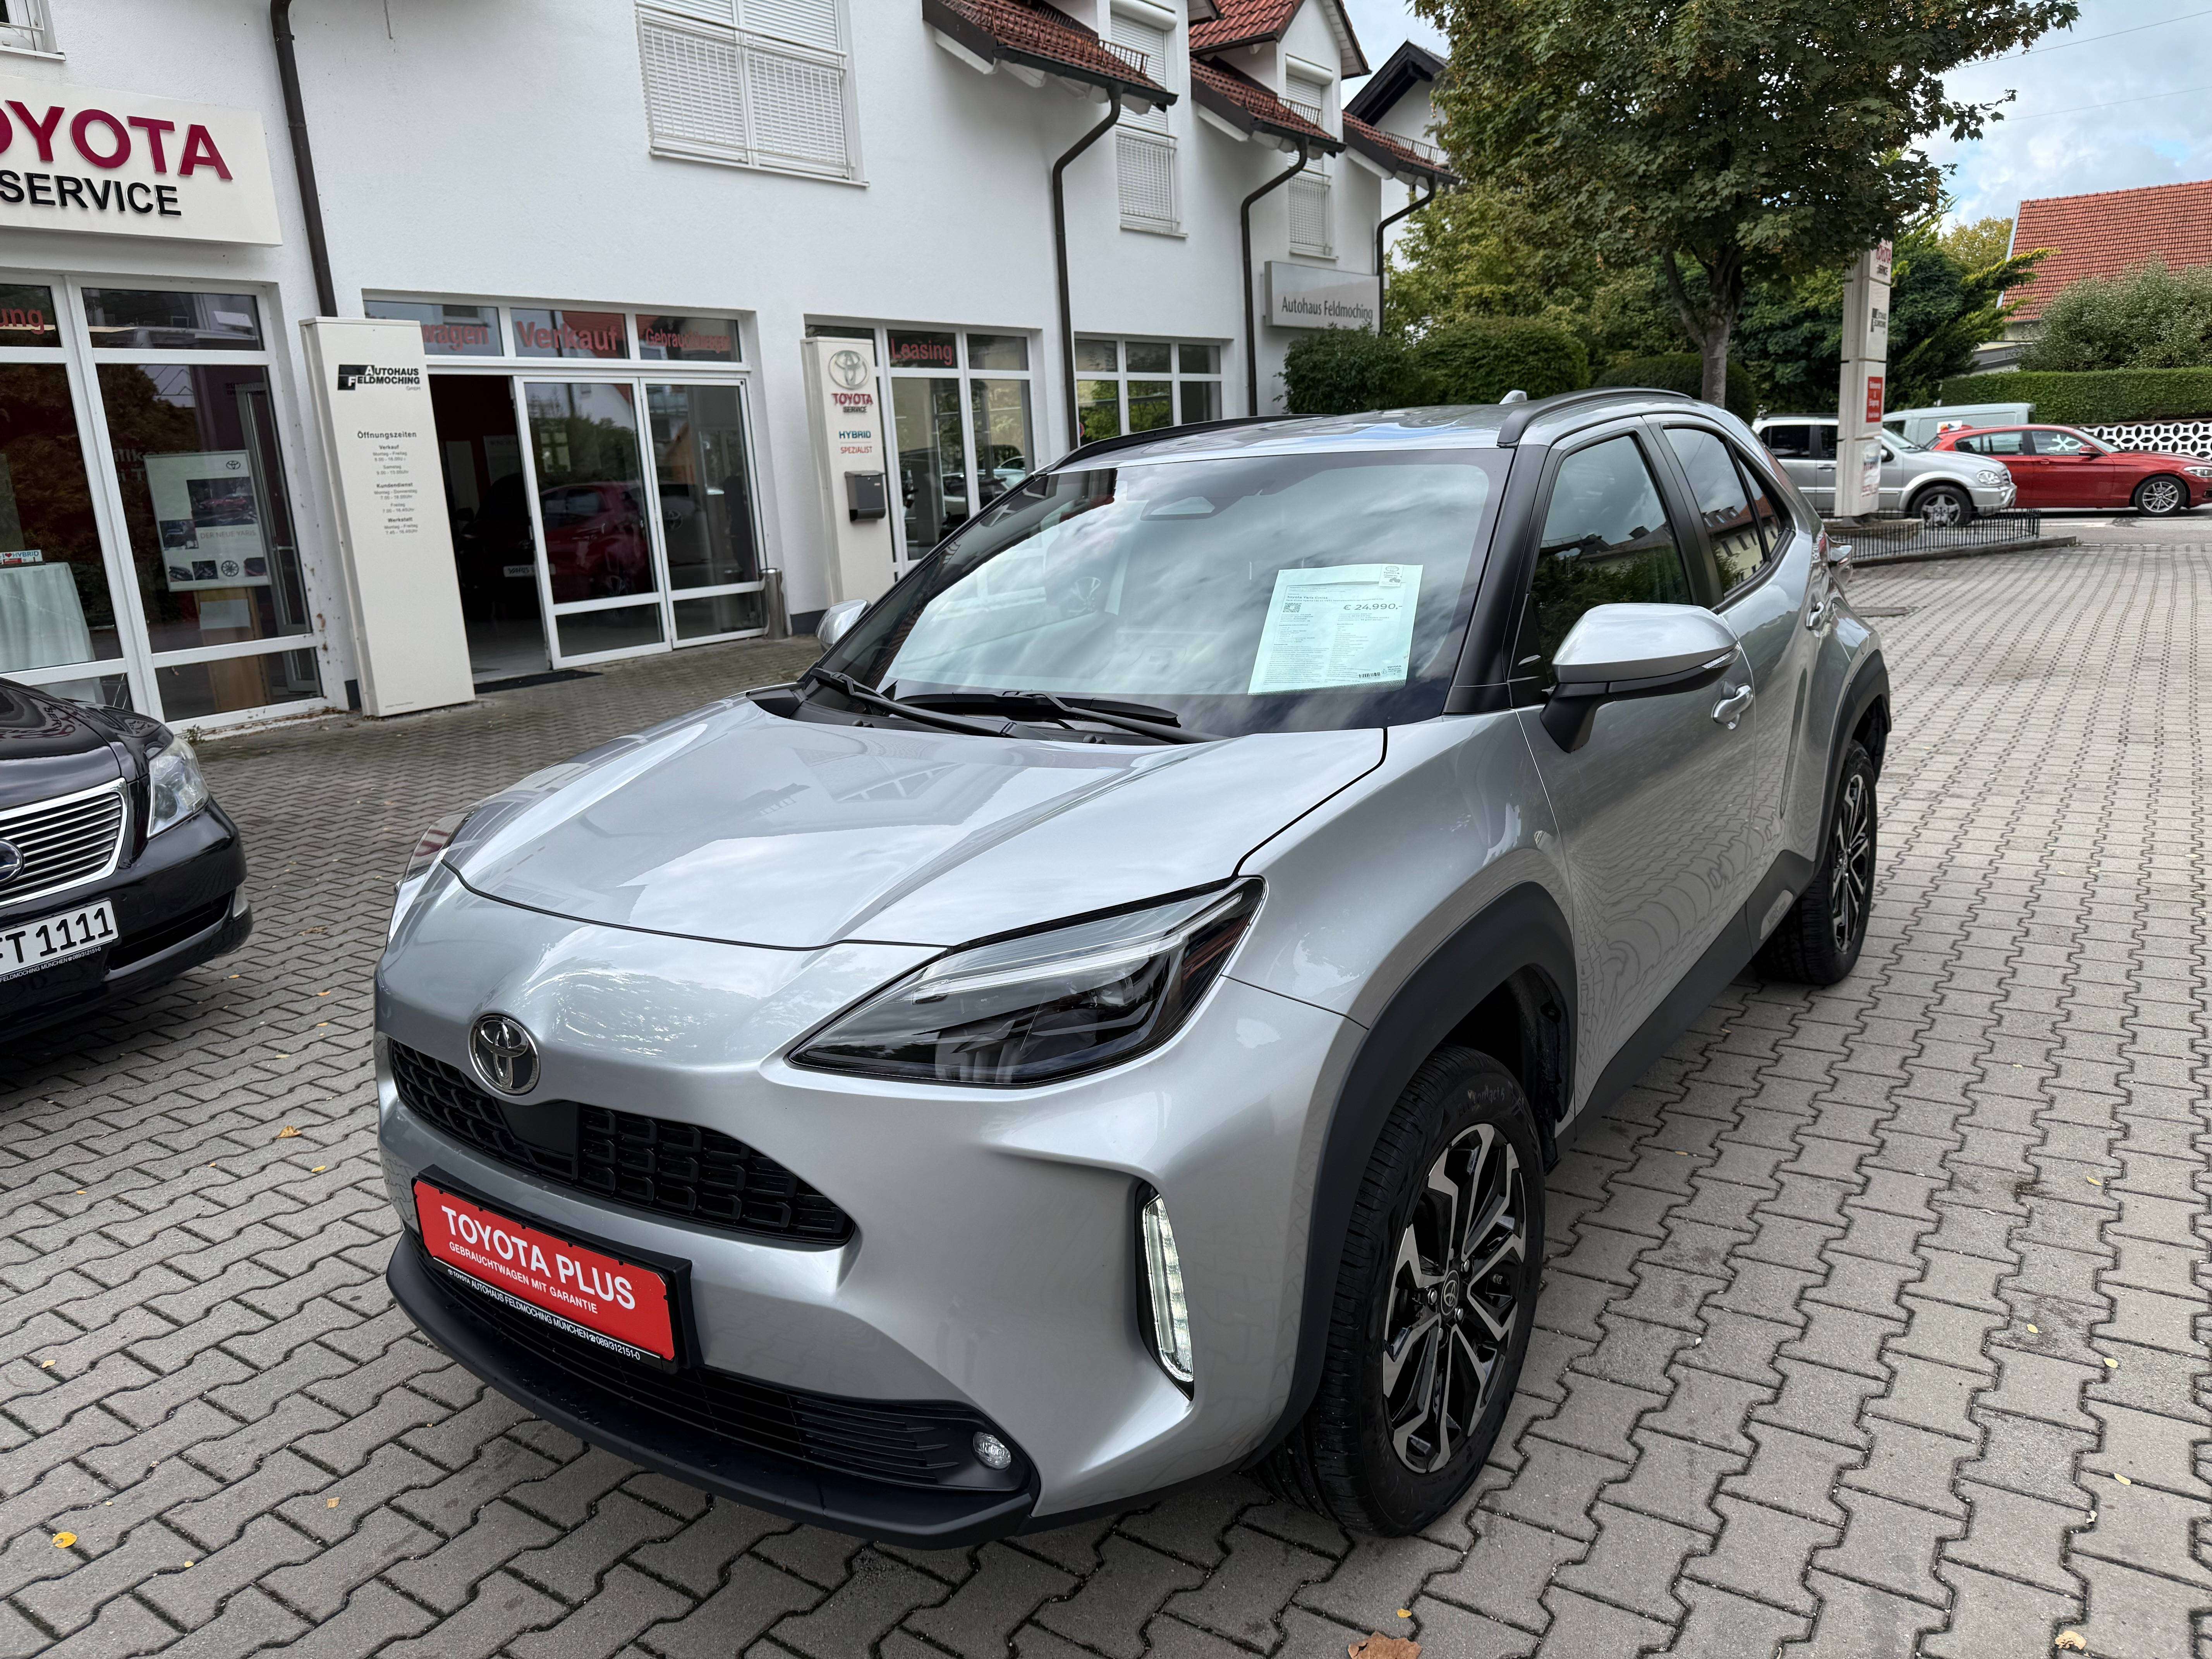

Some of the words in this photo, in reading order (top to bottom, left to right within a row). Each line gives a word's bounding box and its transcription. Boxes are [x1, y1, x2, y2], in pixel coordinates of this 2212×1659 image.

[0, 100, 233, 180] YOTA
[0, 170, 181, 216] SERVICE
[1281, 296, 1322, 315] Autohaus
[1324, 300, 1373, 323] Feldmoching
[517, 320, 617, 350] Verkauf
[891, 337, 953, 366] Leasing
[348, 376, 420, 386] FELDMOCHING
[365, 365, 419, 376] AUTOHAUS
[831, 393, 874, 405] TOYOTA
[357, 430, 417, 440] Öffnungszeiten
[839, 430, 871, 439] HYBRID
[840, 446, 873, 454] SPEZIALIST
[0, 931, 26, 963] T
[36, 907, 113, 957] 1111
[441, 1206, 551, 1278] TOYOTA
[556, 1253, 635, 1310] PLUS
[449, 1241, 529, 1286] GEBRAUCHTWAGEN
[532, 1278, 547, 1293] MIT
[550, 1286, 598, 1314] GARANTIE
[453, 1271, 471, 1285] TOYOTA
[471, 1280, 504, 1302] AUTOHAUS
[505, 1296, 552, 1324] FELDMOCHING
[553, 1317, 589, 1340] MÜNCHEN
[596, 1336, 641, 1360] 089/312151-0
